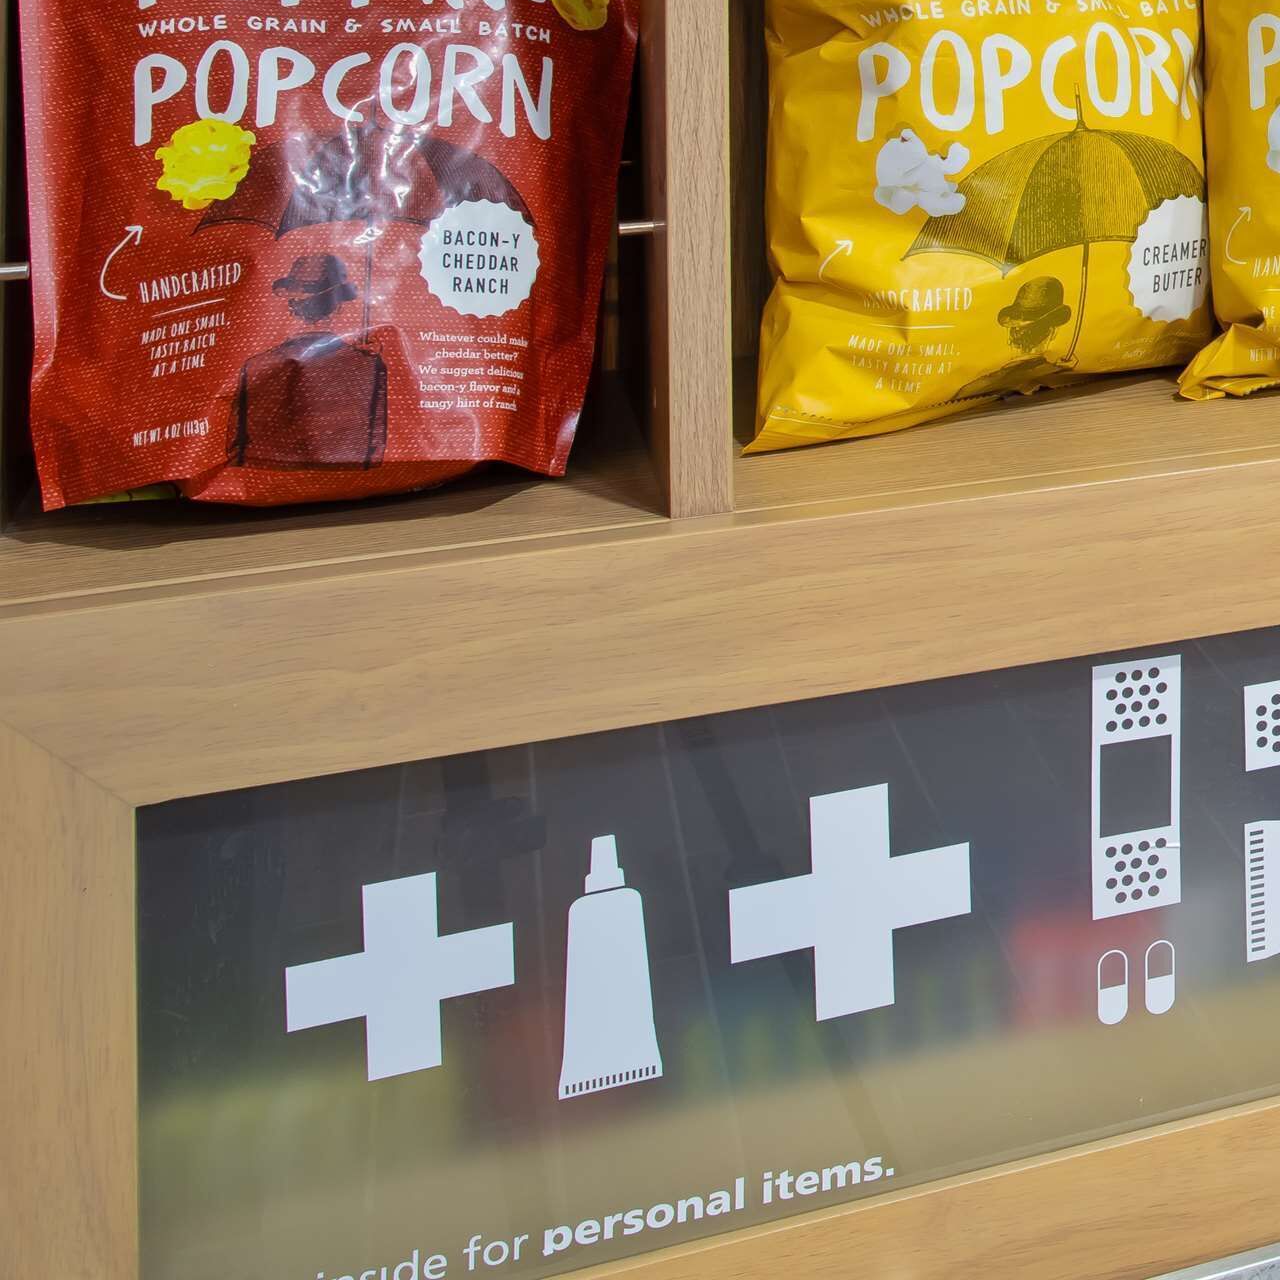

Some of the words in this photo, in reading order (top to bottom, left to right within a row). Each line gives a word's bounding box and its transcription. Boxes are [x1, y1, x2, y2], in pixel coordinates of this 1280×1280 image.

[138, 14, 228, 38] WHOLE
[247, 16, 327, 35] GRAIN
[344, 18, 362, 33] &
[381, 16, 461, 36] SMALL
[479, 21, 551, 44] BATCH
[862, 1, 945, 29] WHOLE
[134, 39, 552, 146] POPCORN
[443, 230, 521, 249] BACON-Y
[1143, 239, 1207, 267] CREAMER
[442, 253, 519, 272] CHEDDAR
[139, 262, 241, 304] HANDCRAFTED
[453, 276, 509, 295] RANCH
[1153, 266, 1202, 293] BUTTER
[141, 327, 167, 346] MADE
[170, 320, 191, 338] ONE
[193, 312, 231, 333] SMALL,
[419, 332, 475, 342] Whatever
[477, 332, 507, 344] could
[150, 341, 180, 361] TASTY
[183, 333, 216, 353] BATCH
[435, 348, 481, 359] cheddar
[483, 349, 518, 361] better?
[419, 365, 438, 375] We
[440, 367, 484, 377] suggest
[462, 1234, 529, 1271] for
[542, 1178, 745, 1257] personal
[762, 1153, 896, 1203] items.
